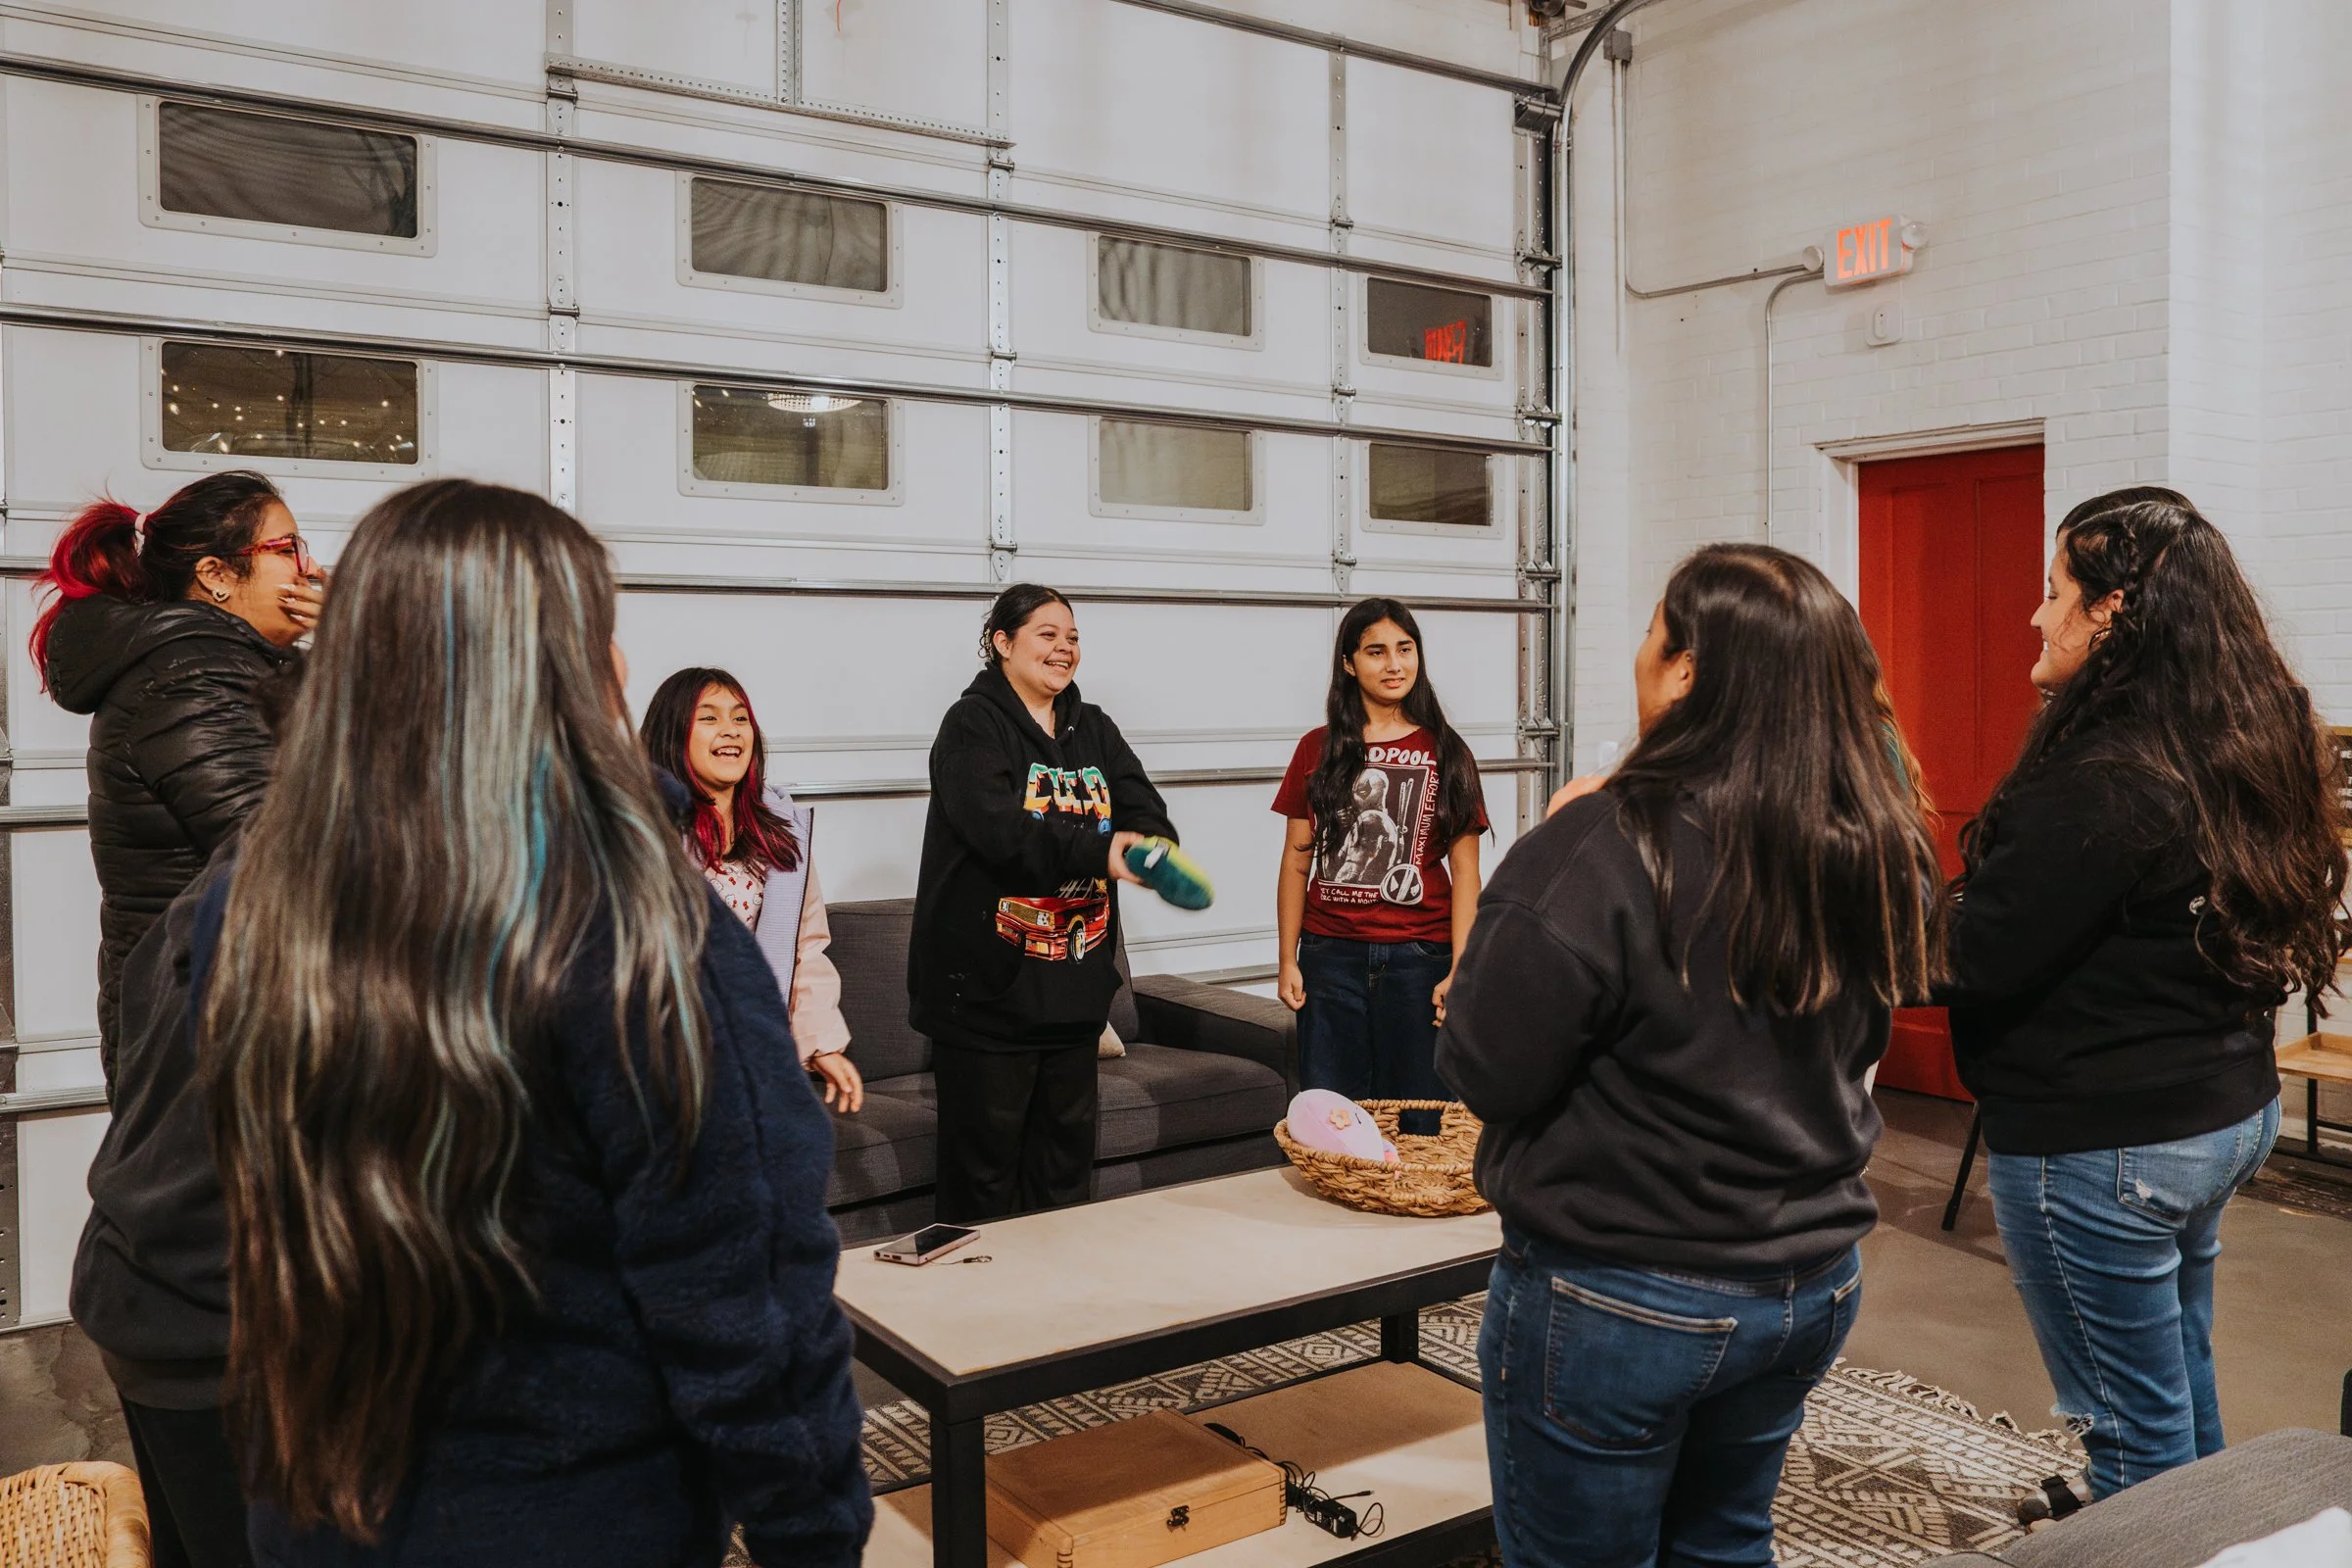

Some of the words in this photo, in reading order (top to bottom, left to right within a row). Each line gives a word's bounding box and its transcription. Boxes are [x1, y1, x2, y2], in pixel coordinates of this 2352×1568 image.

[1838, 219, 1892, 279] EXIT
[1364, 746, 1437, 766] DPOOL
[1424, 770, 1441, 812] EFFORT
[1415, 813, 1435, 865] MAXIMUM
[1331, 888, 1350, 897] CALL
